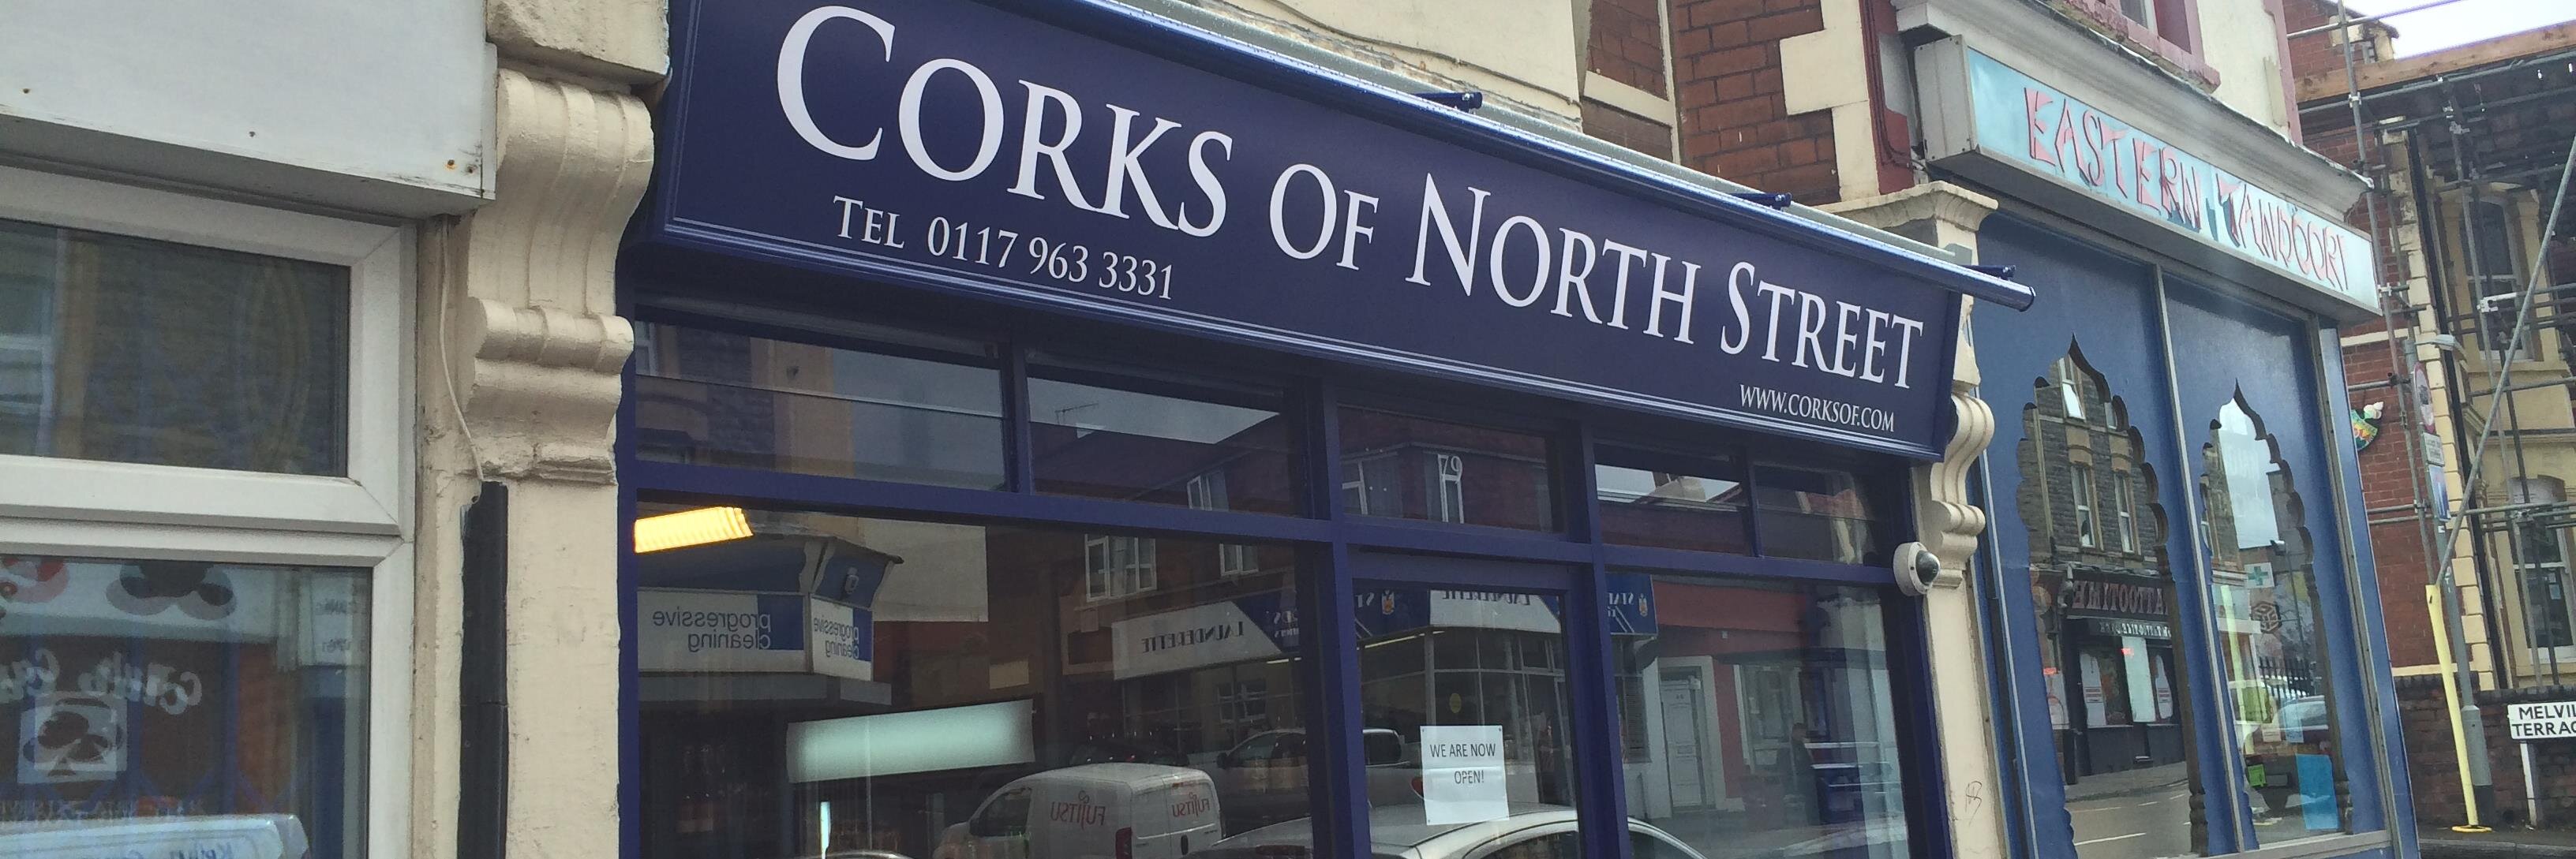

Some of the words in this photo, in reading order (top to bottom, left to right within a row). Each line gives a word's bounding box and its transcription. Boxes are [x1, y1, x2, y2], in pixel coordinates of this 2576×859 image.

[777, 6, 1233, 237] CORKS
[1270, 164, 1379, 270] OF
[1406, 173, 1701, 344] NORTH
[1721, 262, 1923, 388] STREET
[2024, 87, 2201, 233] EASTERN
[2215, 172, 2349, 291] TANDOORI
[833, 195, 905, 248] TEL
[927, 216, 1019, 268] 0117
[1029, 237, 1088, 282] 963
[1099, 252, 1173, 300] 3331
[1739, 384, 1894, 432] WWW.CORKSOF.COM
[1429, 744, 1447, 757] WE
[1449, 744, 1468, 756] ARE
[1470, 743, 1496, 756] NOW
[1454, 770, 1485, 784] OPEN!
